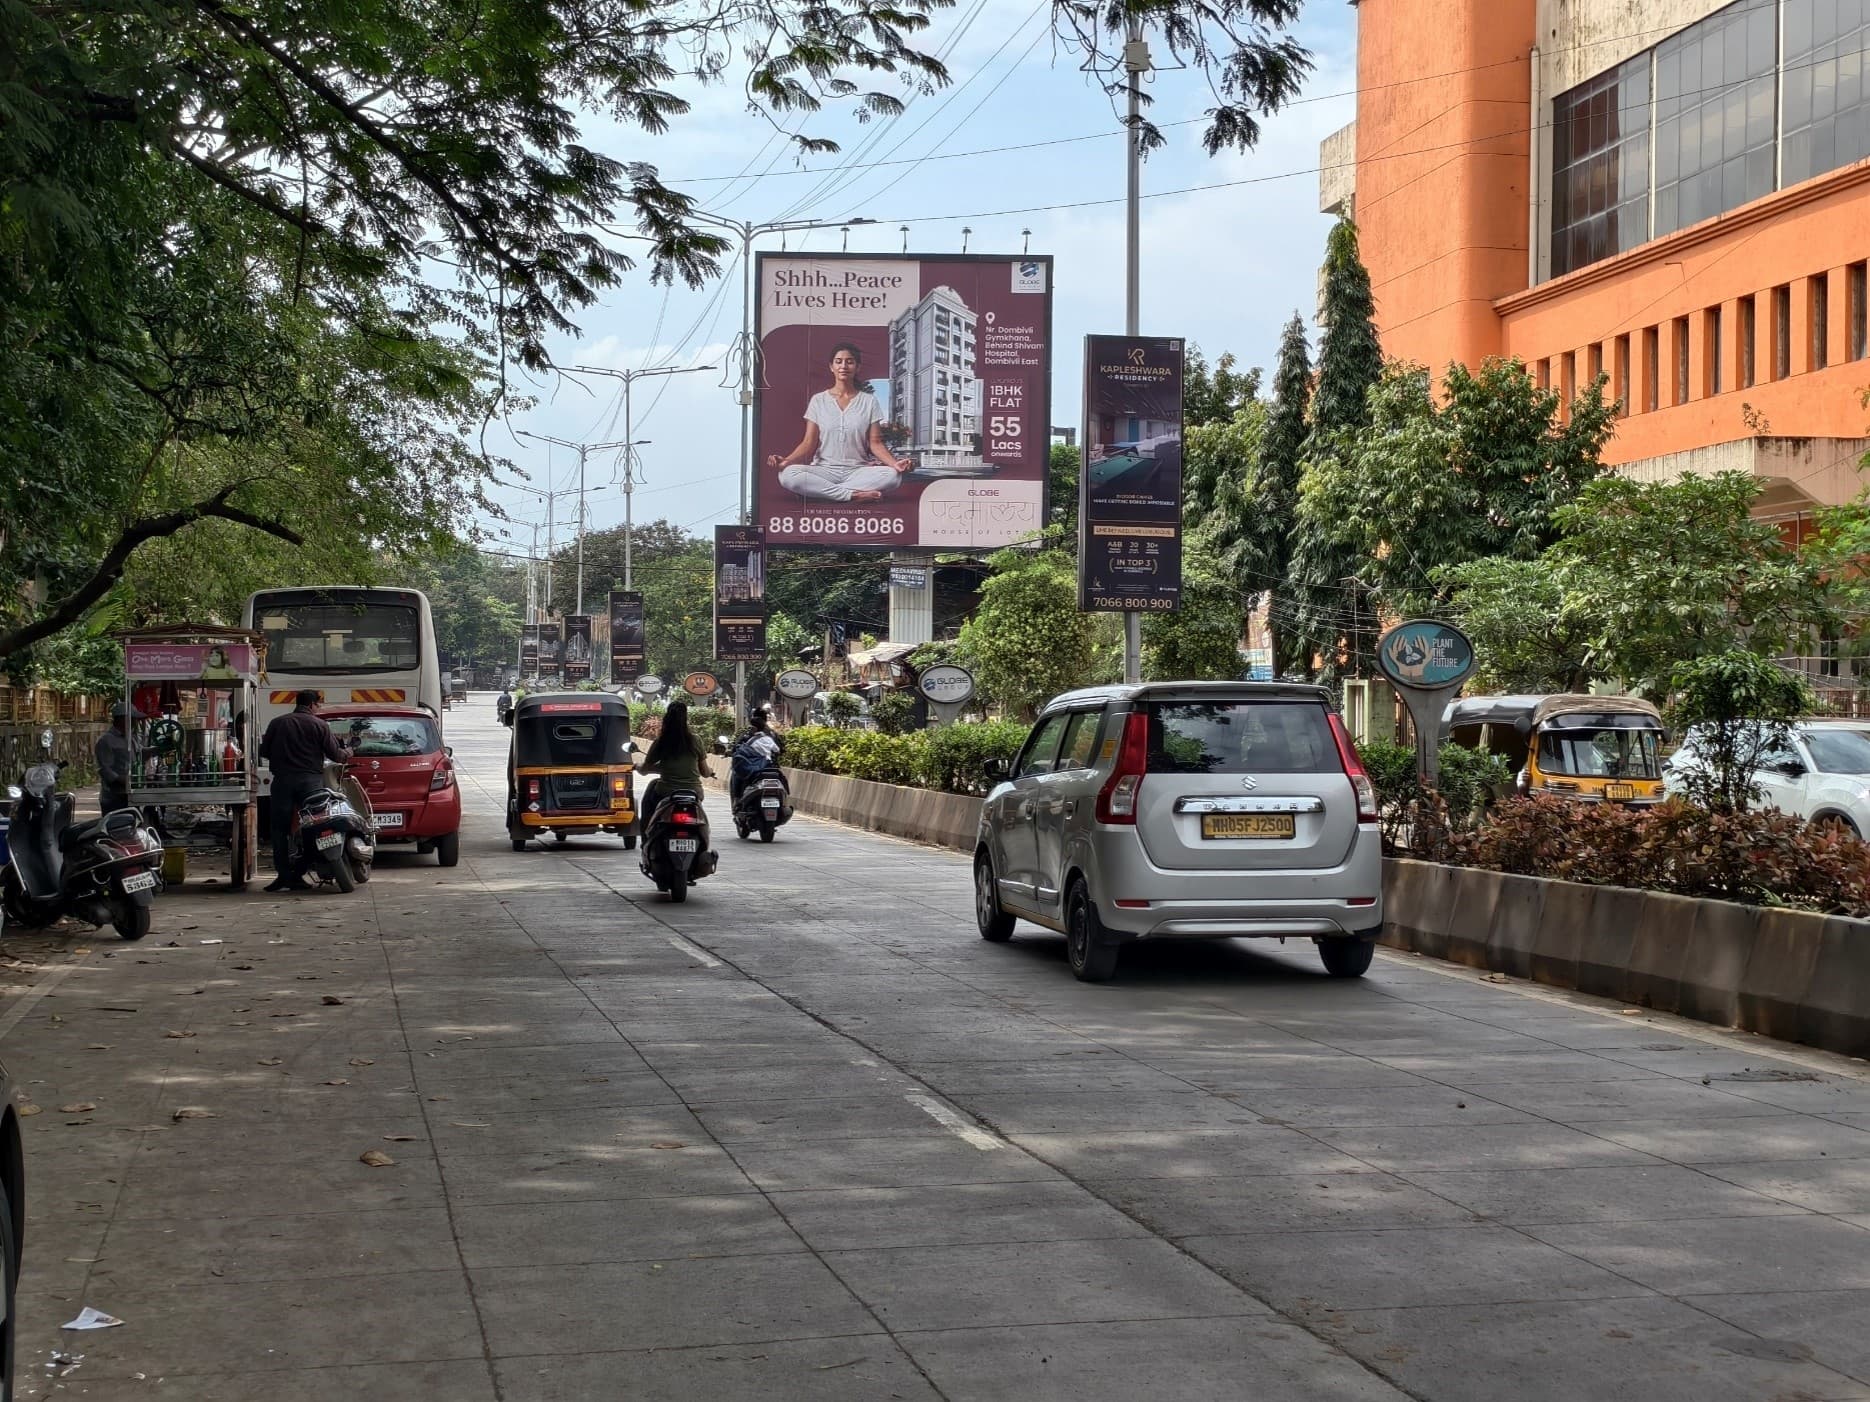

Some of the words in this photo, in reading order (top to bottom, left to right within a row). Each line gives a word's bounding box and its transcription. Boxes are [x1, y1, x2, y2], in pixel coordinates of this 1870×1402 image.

[775, 270, 902, 288] Shhh...Peace
[775, 290, 826, 308] Lives
[831, 292, 887, 309] Here!
[998, 326, 1034, 334] Dombivli
[985, 357, 1020, 365] Dombivli
[1021, 358, 1039, 366] East
[1100, 365, 1172, 376] KAPLESHWARA
[1114, 374, 1158, 382] RESIDENCY
[989, 385, 1023, 396] 1BHK
[989, 397, 1022, 408] FLAT
[989, 416, 1021, 437] 55
[991, 439, 1022, 450] Lacs
[967, 489, 1000, 497] GLOBE
[768, 516, 794, 533] 88
[799, 517, 849, 534] 8086
[854, 517, 904, 534] 8086
[1127, 559, 1144, 567] TOP
[1093, 597, 1123, 607] 7066
[1125, 598, 1148, 608] 800
[1150, 599, 1173, 609] 900
[1432, 638, 1454, 649] PLANT
[1432, 648, 1446, 658] THE
[1432, 657, 1459, 668] FUTURE
[937, 677, 969, 685] GLOBE
